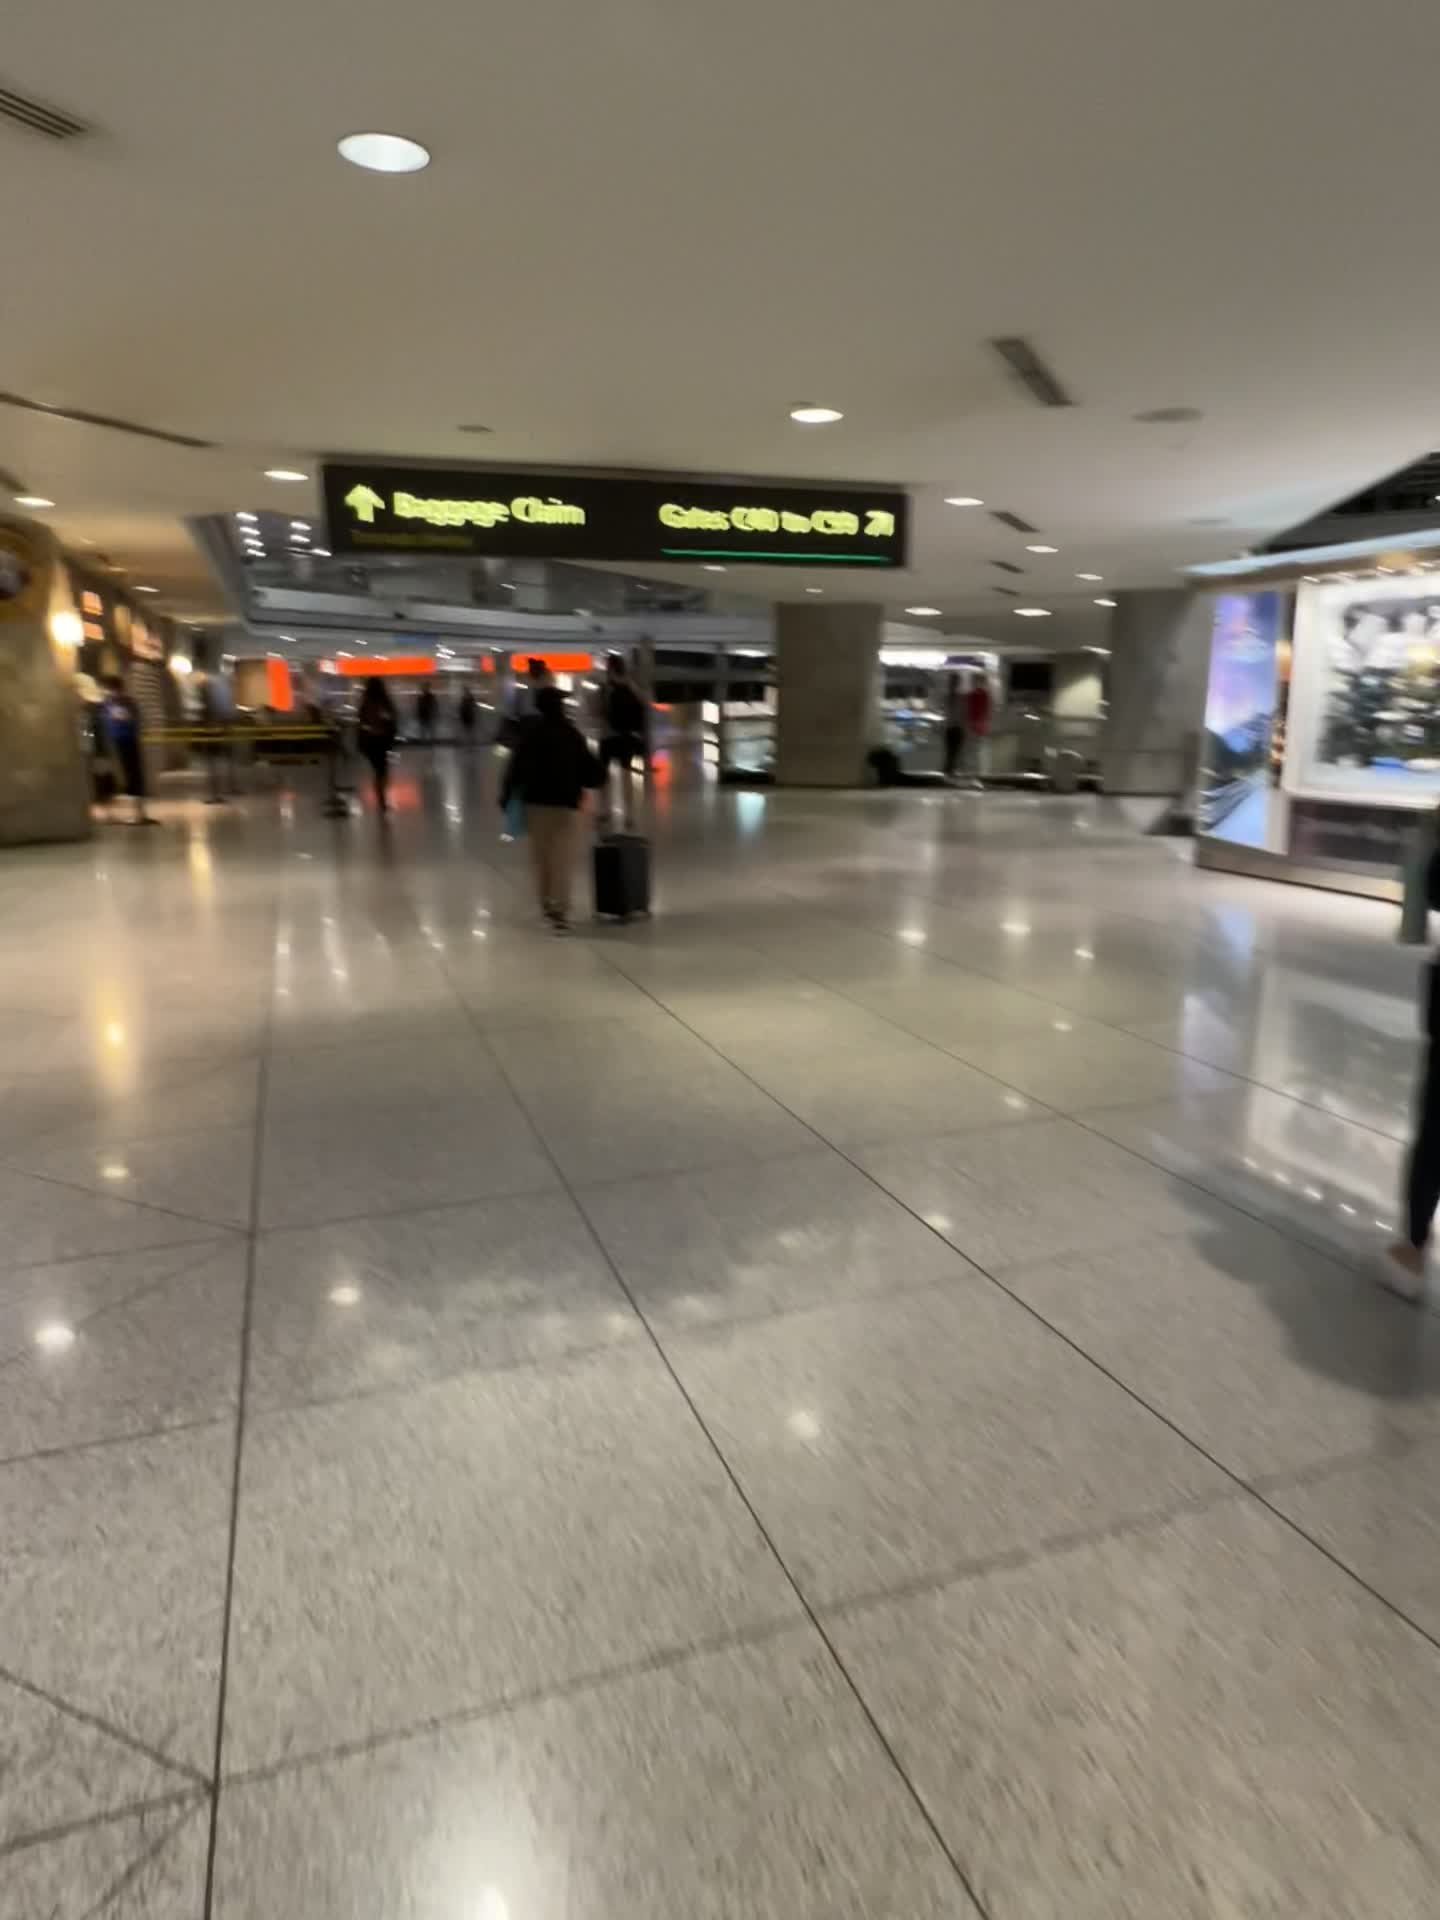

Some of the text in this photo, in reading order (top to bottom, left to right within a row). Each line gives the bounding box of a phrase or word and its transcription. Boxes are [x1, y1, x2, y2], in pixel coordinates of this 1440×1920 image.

[393, 491, 586, 528] Baggage Claim
[658, 503, 730, 531] Gates
